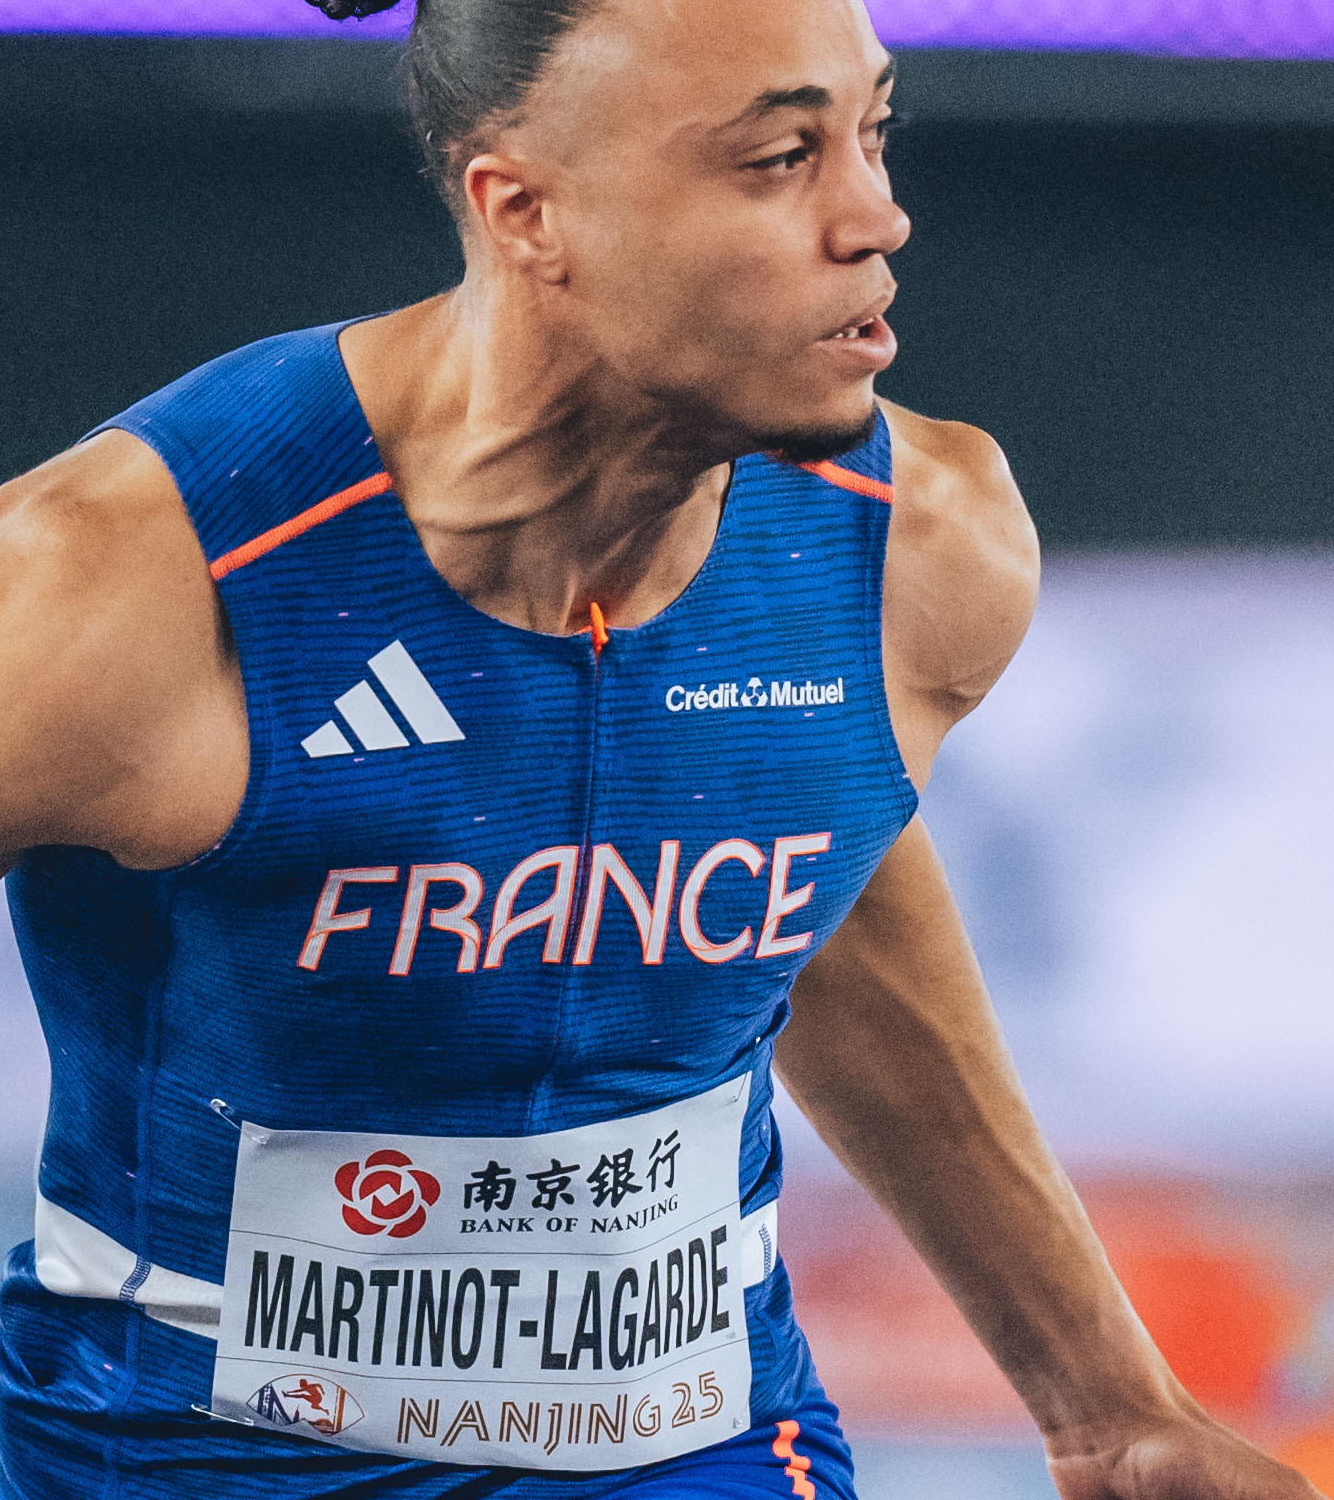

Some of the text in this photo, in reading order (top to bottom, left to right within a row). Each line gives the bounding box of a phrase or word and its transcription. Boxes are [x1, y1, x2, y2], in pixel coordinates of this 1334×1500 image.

[665, 677, 844, 712] Crédit Mutuel
[297, 832, 831, 976] FRANCE
[460, 1194, 679, 1234] BANK OF NANJING
[245, 1224, 730, 1371] MARTINOT-LAGARDE
[396, 1370, 724, 1456] NANJING 25
